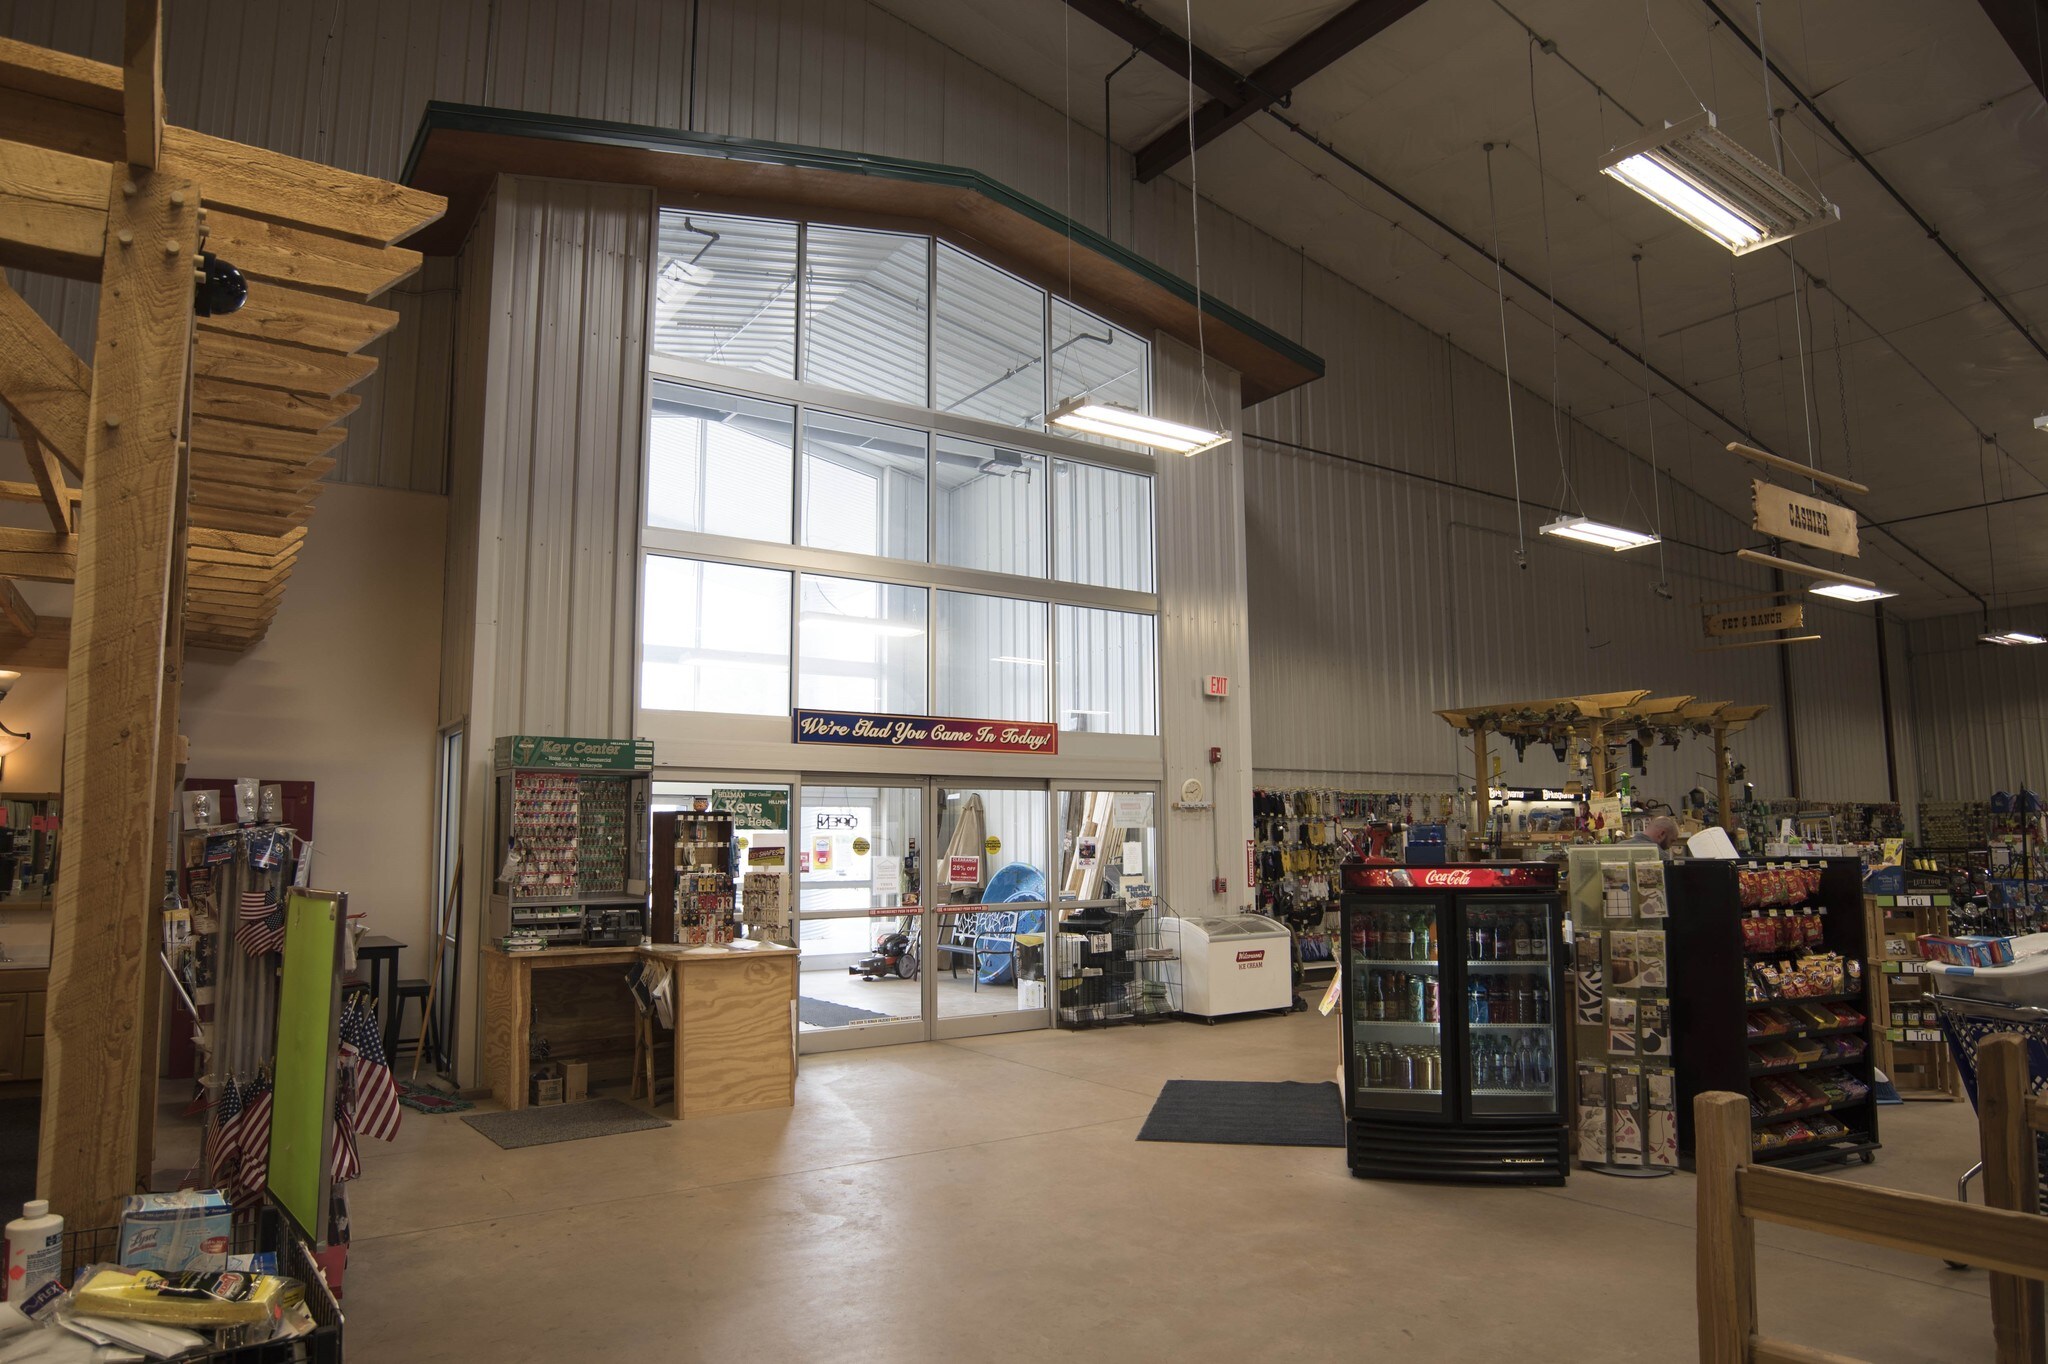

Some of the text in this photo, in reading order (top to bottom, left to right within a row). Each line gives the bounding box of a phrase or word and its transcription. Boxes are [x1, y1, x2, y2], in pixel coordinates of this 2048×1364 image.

[1788, 503, 1830, 537] CASHIER
[1722, 617, 1738, 630] PET
[1751, 612, 1782, 626] RANCH
[1211, 676, 1228, 694] EXIT
[800, 717, 1051, 750] We're Glad You Came In Today!
[541, 740, 571, 755] Key
[573, 741, 621, 755] Center
[724, 800, 763, 817] Keys
[735, 817, 772, 826] de Here
[1425, 869, 1473, 885] Coca-Cola
[1928, 878, 1942, 886] TOOL
[1125, 884, 1151, 893] Thrifty
[1904, 896, 1923, 906] Tru
[1247, 961, 1263, 969] CREAM
[1914, 1030, 1933, 1041] Tru
[130, 1228, 160, 1248] Lysol
[37, 1284, 60, 1302] FLEX
